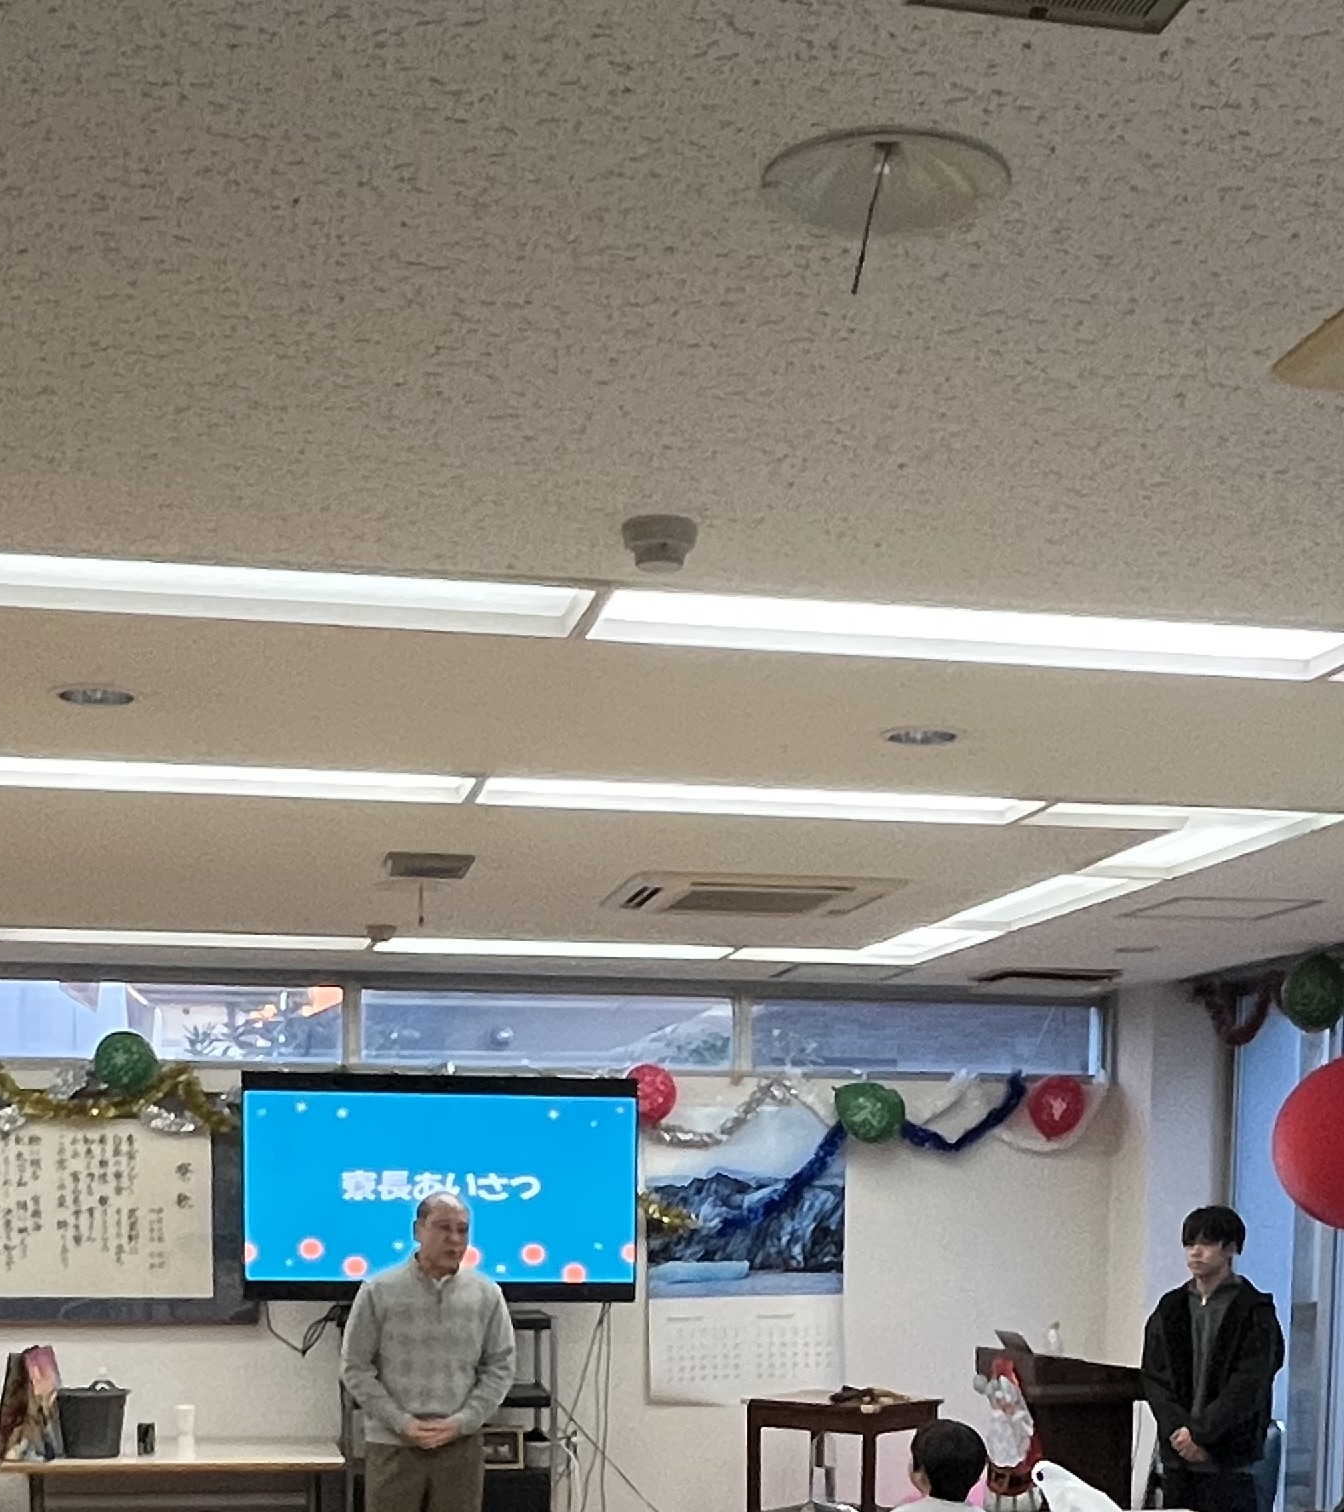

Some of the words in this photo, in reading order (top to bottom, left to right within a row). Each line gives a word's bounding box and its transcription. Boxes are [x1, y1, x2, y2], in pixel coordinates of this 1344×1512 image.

[341, 1169, 542, 1202] 寮長あいさつ
